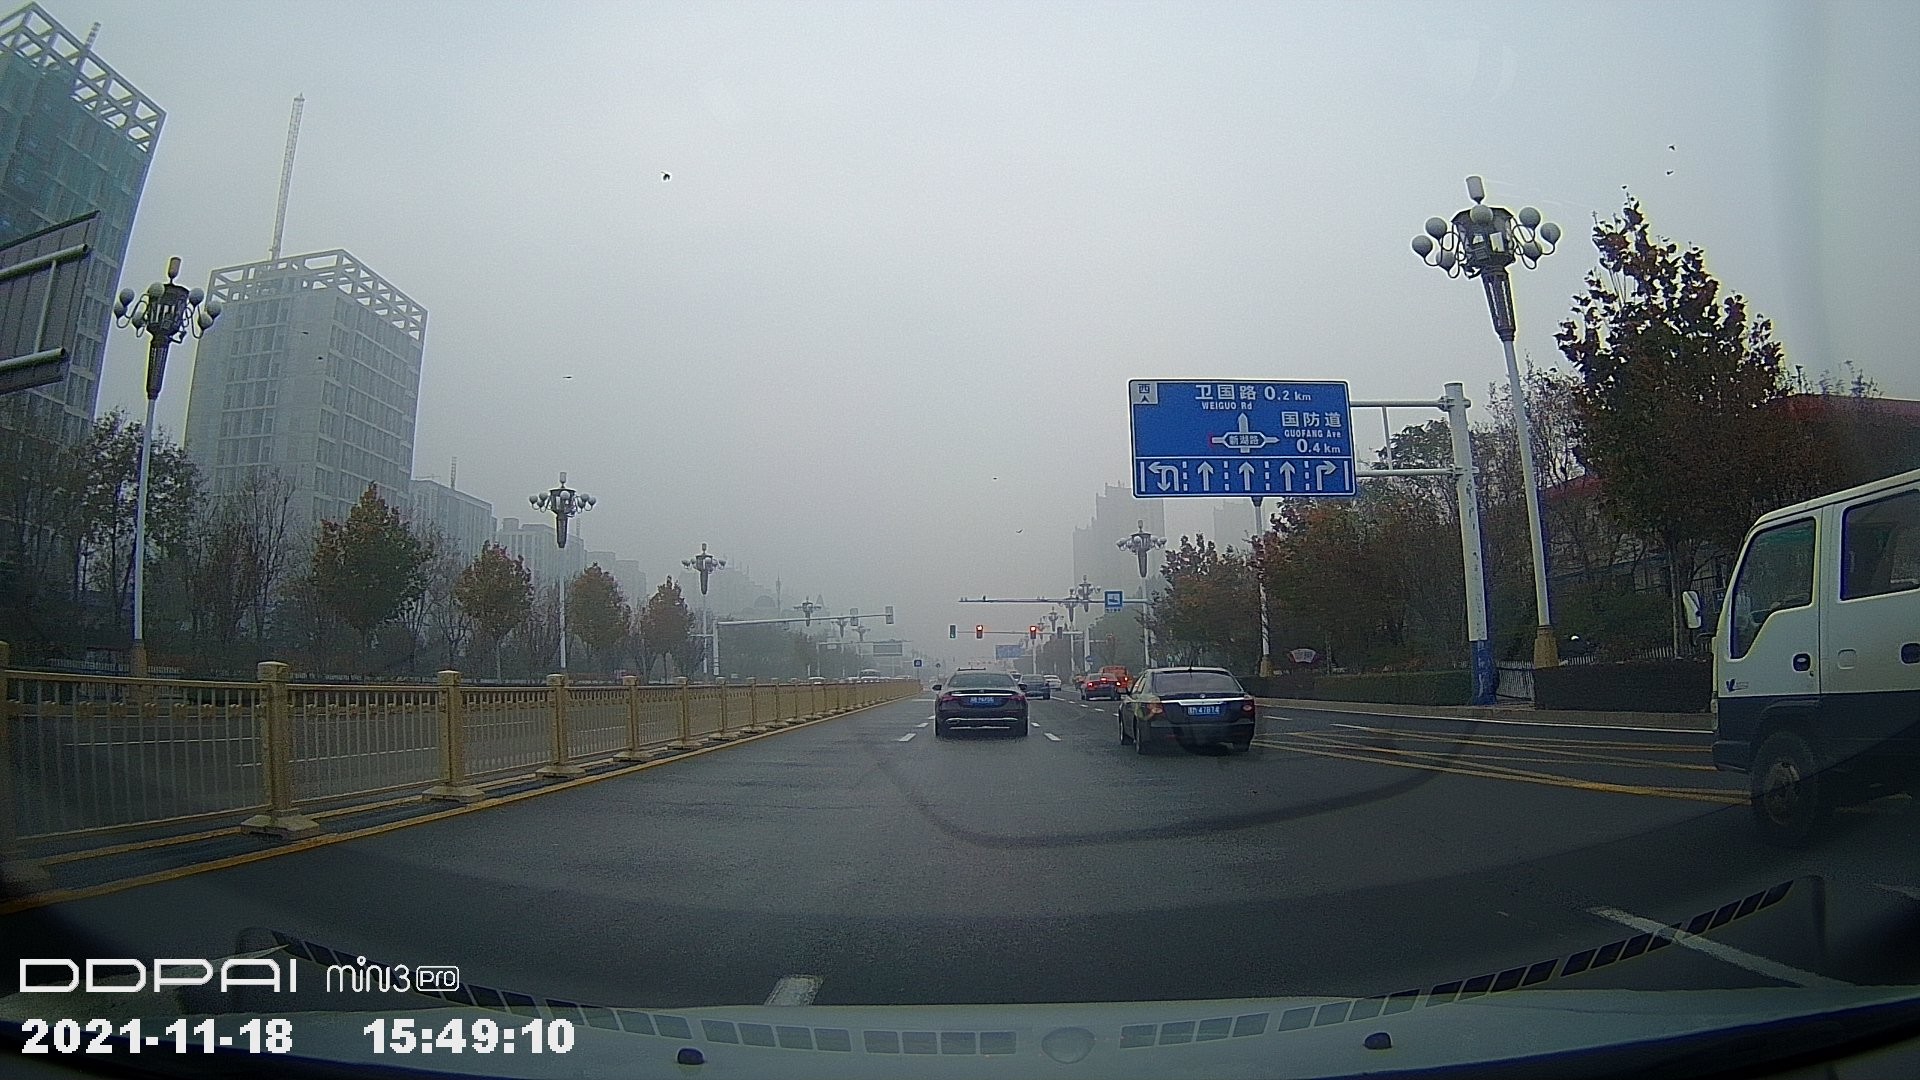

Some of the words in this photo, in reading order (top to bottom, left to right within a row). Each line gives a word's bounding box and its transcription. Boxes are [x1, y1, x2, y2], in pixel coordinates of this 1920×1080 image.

[1138, 383, 1150, 394] 西
[1195, 384, 1256, 400] 卫国路
[1264, 385, 1289, 401] 0.2
[1295, 391, 1311, 401] km
[1202, 401, 1236, 410] WEIGUO
[1241, 402, 1252, 410] Rd
[1281, 411, 1341, 428] 国防道
[1284, 429, 1323, 438] GUOFANG
[1327, 429, 1341, 438] Ave
[1296, 438, 1320, 453] 0.4
[1324, 443, 1341, 453] km
